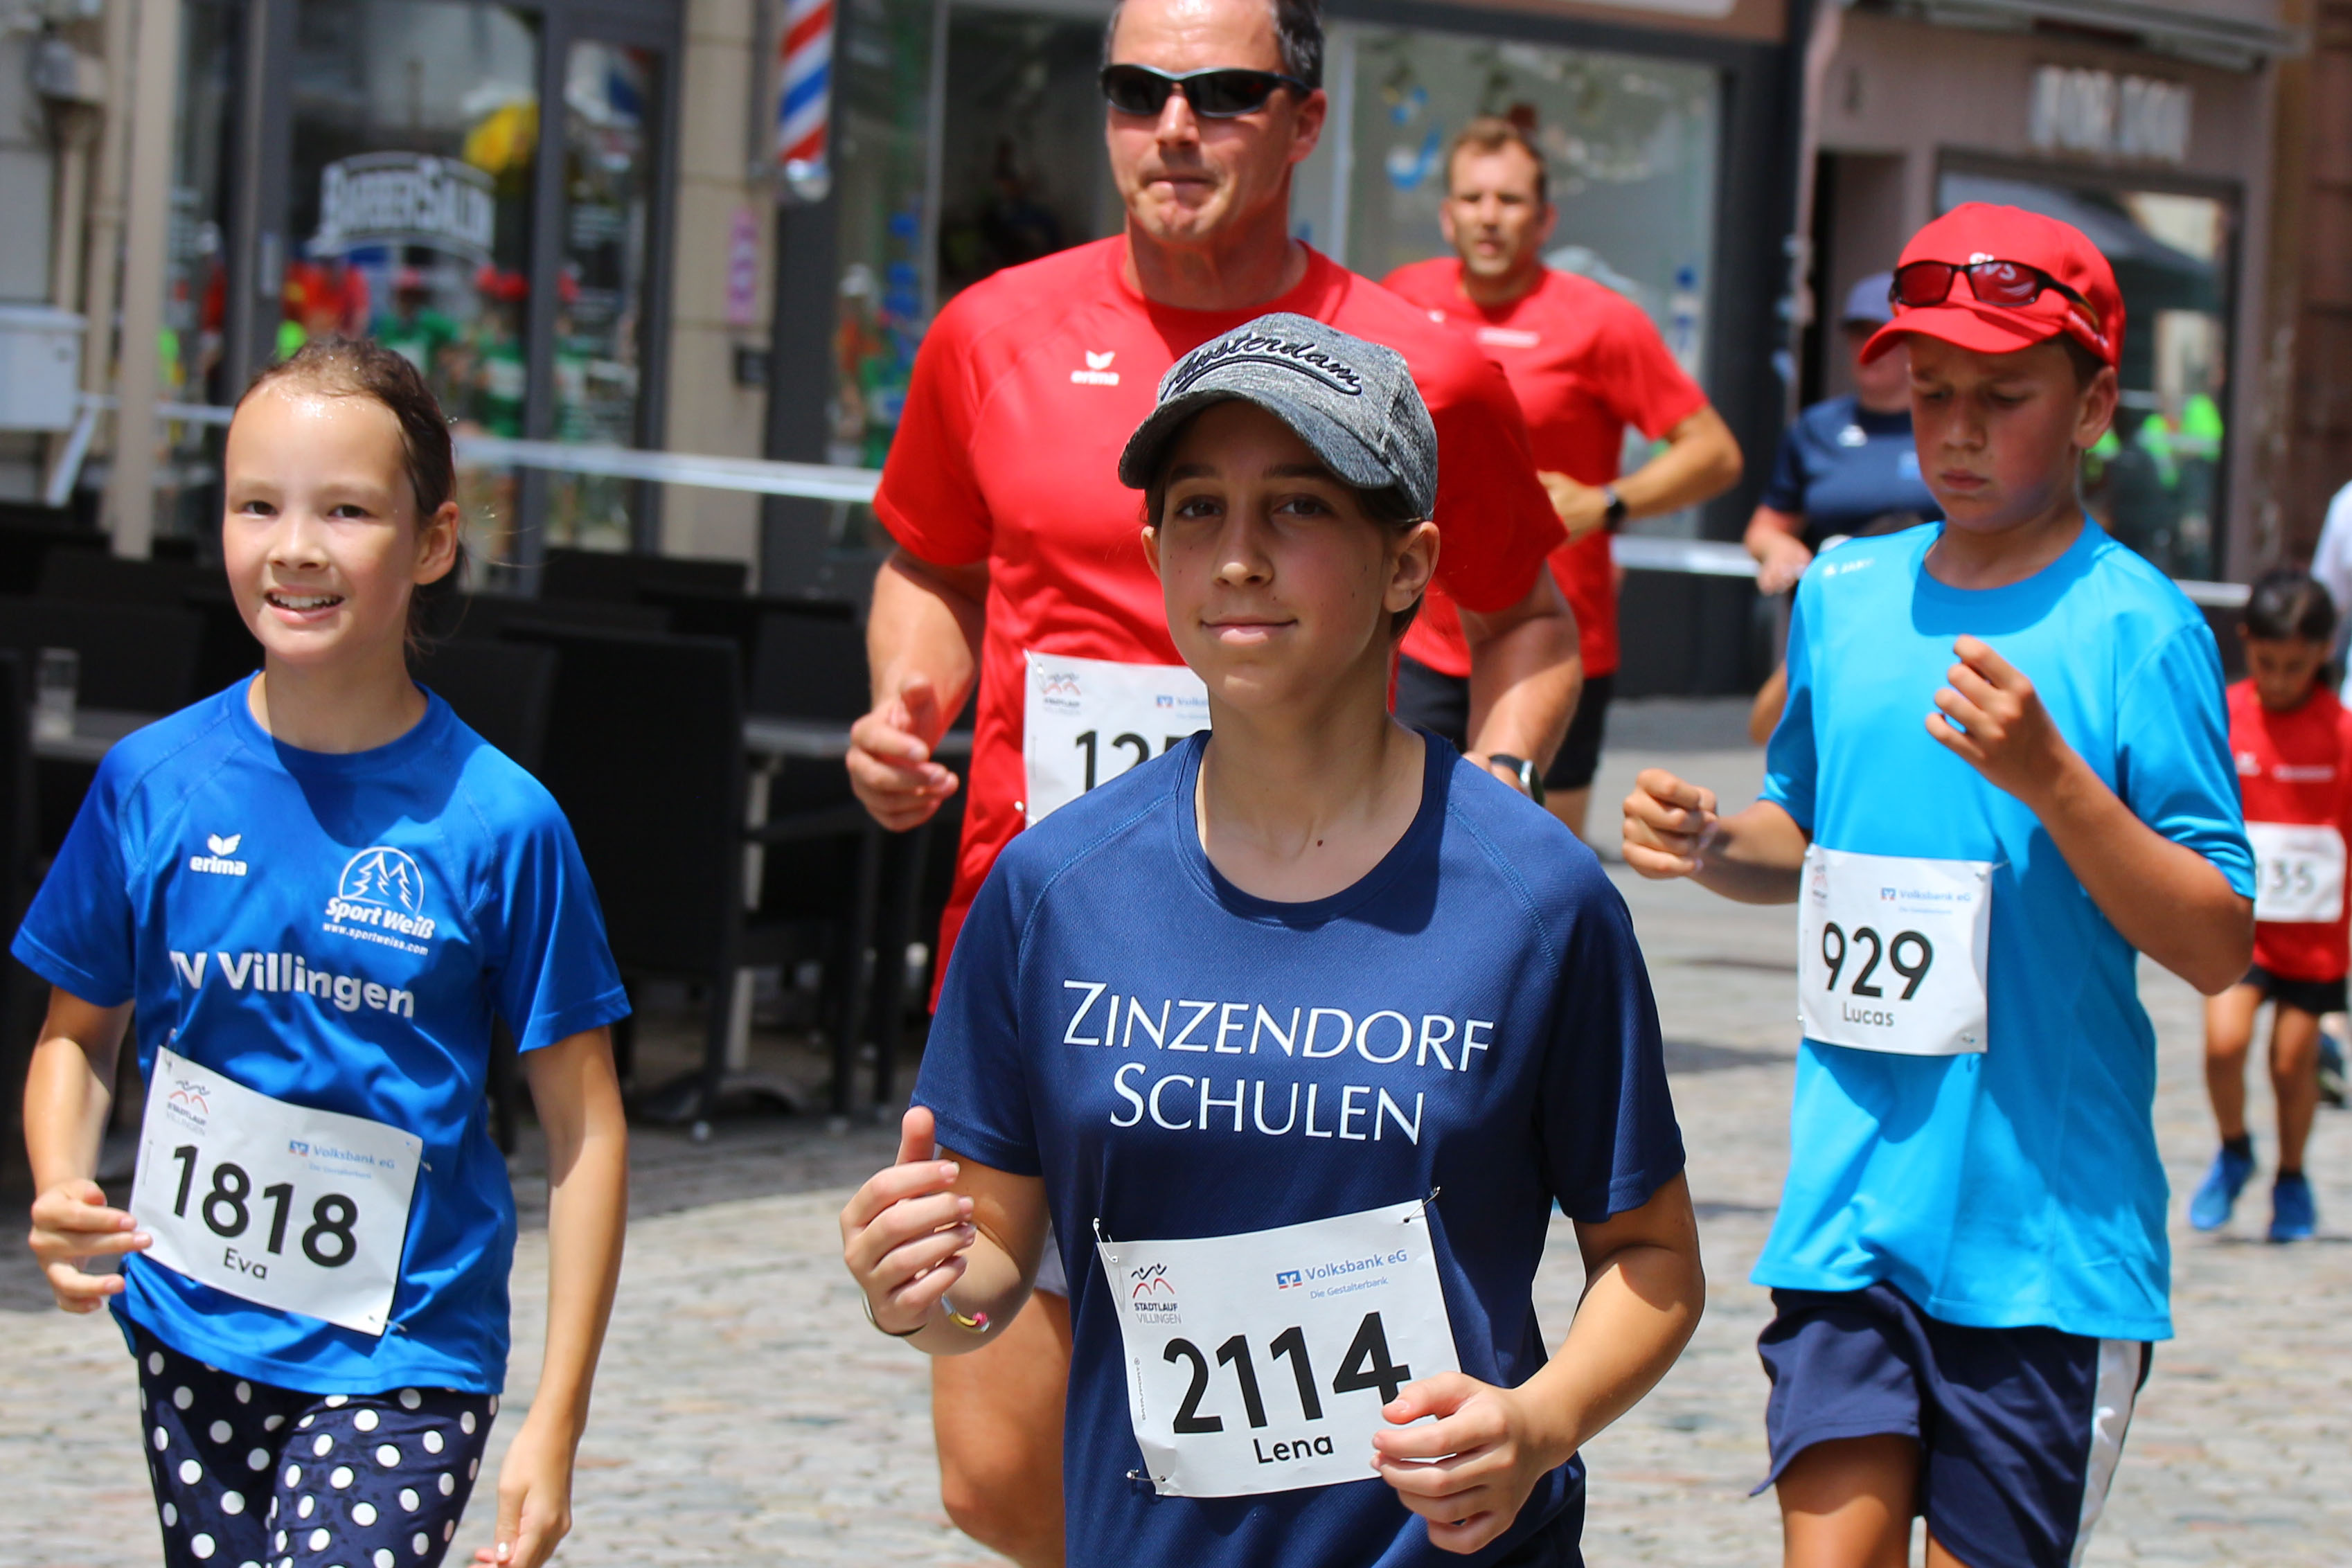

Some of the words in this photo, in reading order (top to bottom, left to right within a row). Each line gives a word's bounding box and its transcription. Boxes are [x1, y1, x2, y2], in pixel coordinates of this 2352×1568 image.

[1076, 730, 1186, 792] 12
[189, 855, 247, 877] erima
[326, 897, 383, 925] Sport
[380, 909, 435, 939] Weiß
[322, 923, 428, 956] www.sportweiss.com
[1823, 921, 1934, 1000] 929
[217, 952, 415, 1018] Villingen
[1063, 979, 1494, 1072] ZINZENDORF
[1842, 1001, 1894, 1026] Lucas
[1110, 1062, 1424, 1146] SCHULEN
[313, 1145, 375, 1165] Volksbank
[379, 1159, 395, 1169] eG
[172, 1144, 360, 1269] 1818
[222, 1247, 268, 1280] Eva
[1305, 1253, 1384, 1281] Volksbank
[1387, 1249, 1408, 1265] eG
[1310, 1288, 1326, 1299] Die
[1327, 1276, 1389, 1297] Gestalterbank
[1134, 1302, 1178, 1312] STADTLAUF
[1137, 1312, 1182, 1324] VILLINGEN
[1163, 1310, 1412, 1434] 2114
[1252, 1435, 1334, 1465] Lena
